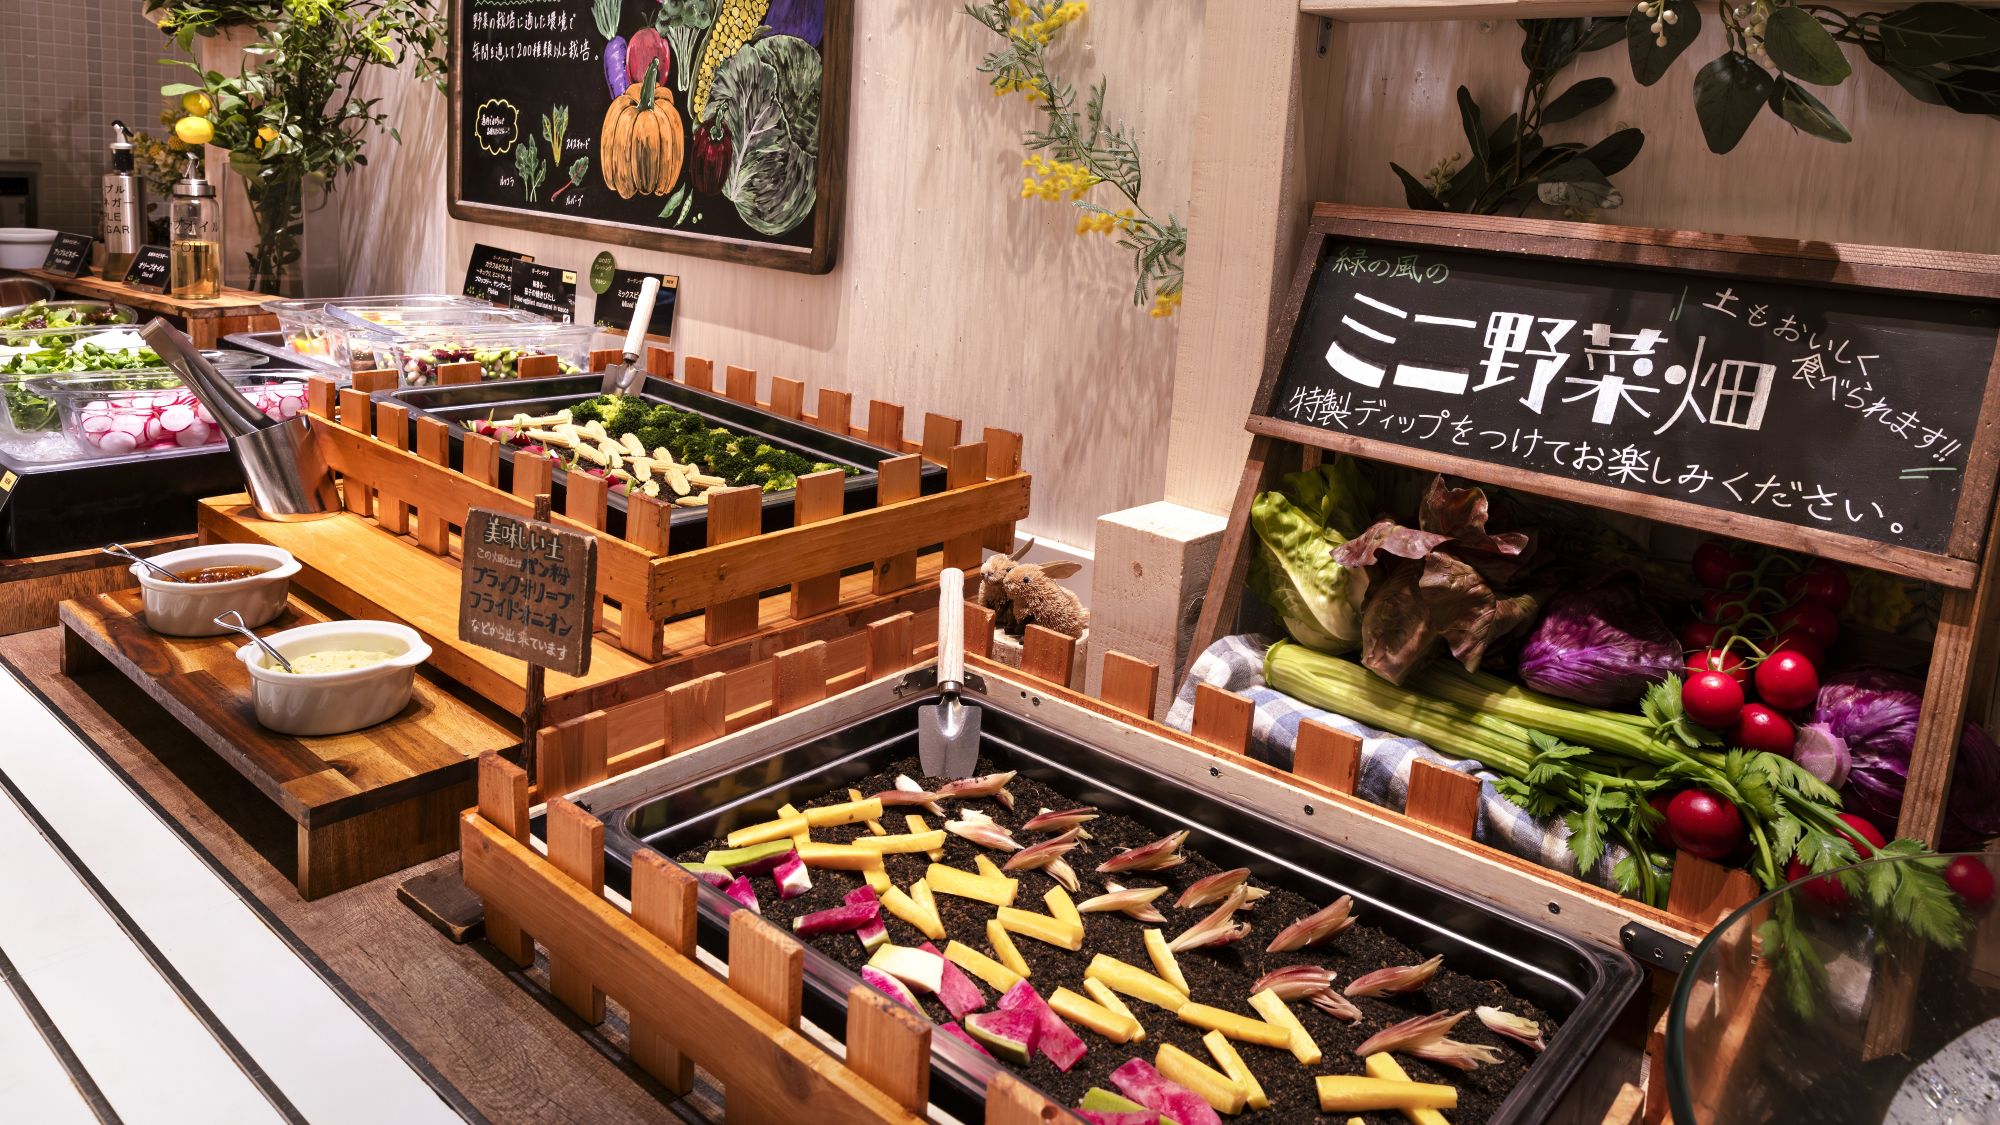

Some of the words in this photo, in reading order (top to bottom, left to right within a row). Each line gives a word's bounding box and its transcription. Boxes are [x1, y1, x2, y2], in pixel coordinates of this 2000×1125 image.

[1331, 246, 1450, 285] 緑の風の
[1701, 287, 1882, 368] 土もおいしく
[1325, 291, 1778, 436] ミニ野菜畑
[1288, 385, 1906, 536] 特製ディップをつけてお楽しみください。
[484, 517, 564, 561] 美味しい土
[472, 566, 575, 610] ブラックオリーブ
[469, 590, 574, 637] フライドオニオン
[471, 618, 569, 661] などから出来ています
